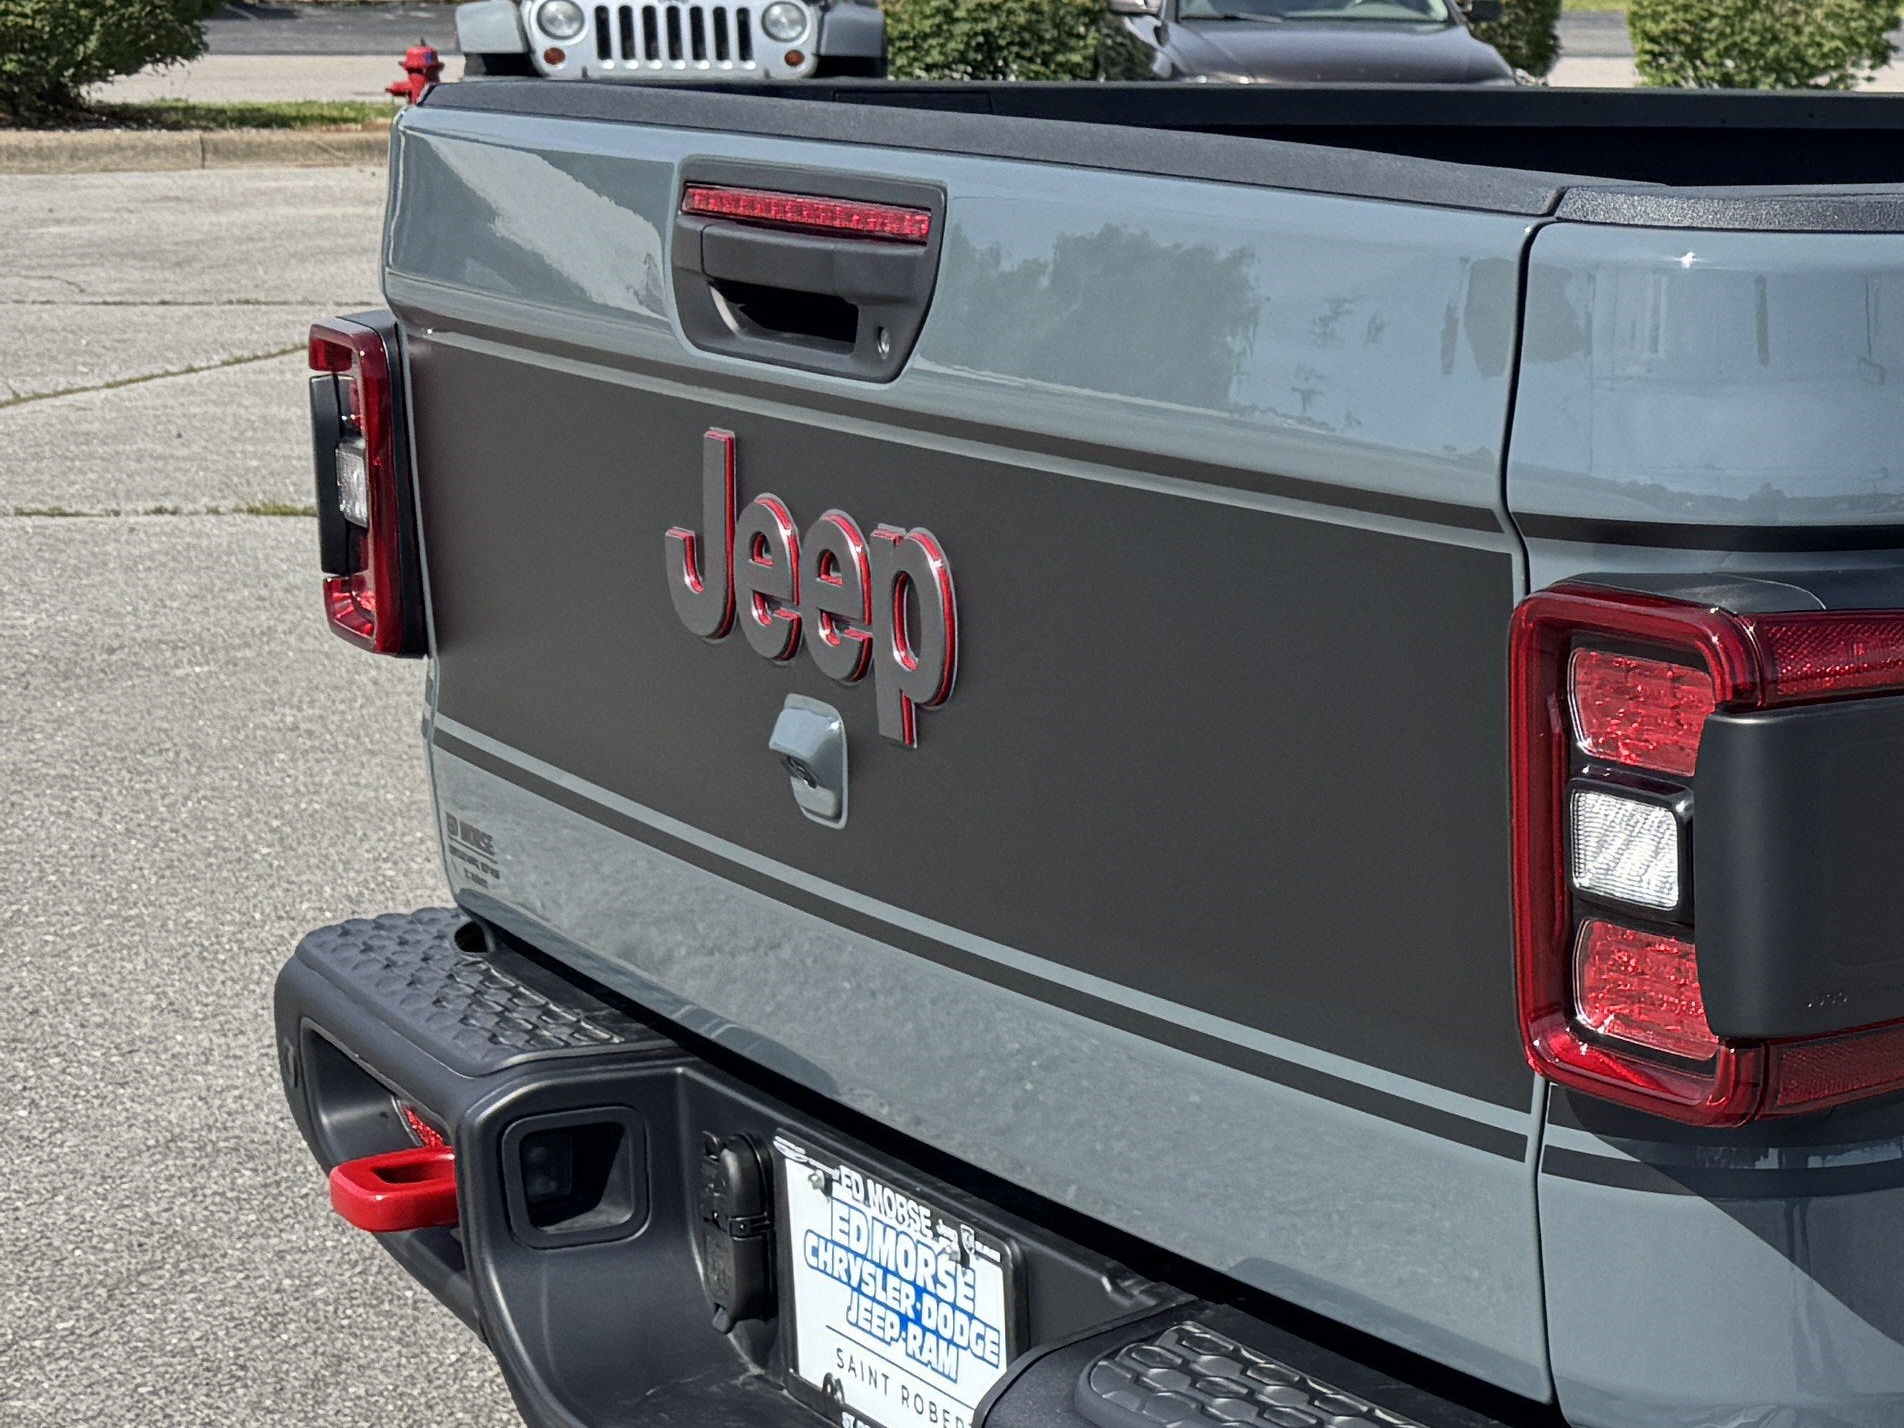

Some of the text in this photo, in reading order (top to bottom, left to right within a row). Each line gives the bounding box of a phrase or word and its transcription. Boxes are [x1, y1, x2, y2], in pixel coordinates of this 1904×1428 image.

[663, 426, 959, 749] Jeep
[831, 1196, 976, 1314] ED MORSE
[838, 1164, 865, 1203] ED
[866, 1178, 934, 1240] MORSE
[804, 1229, 1001, 1369] CHRYSLER DODGE
[846, 1290, 959, 1384] JEEP RAM
[835, 1347, 891, 1397] SAINT
